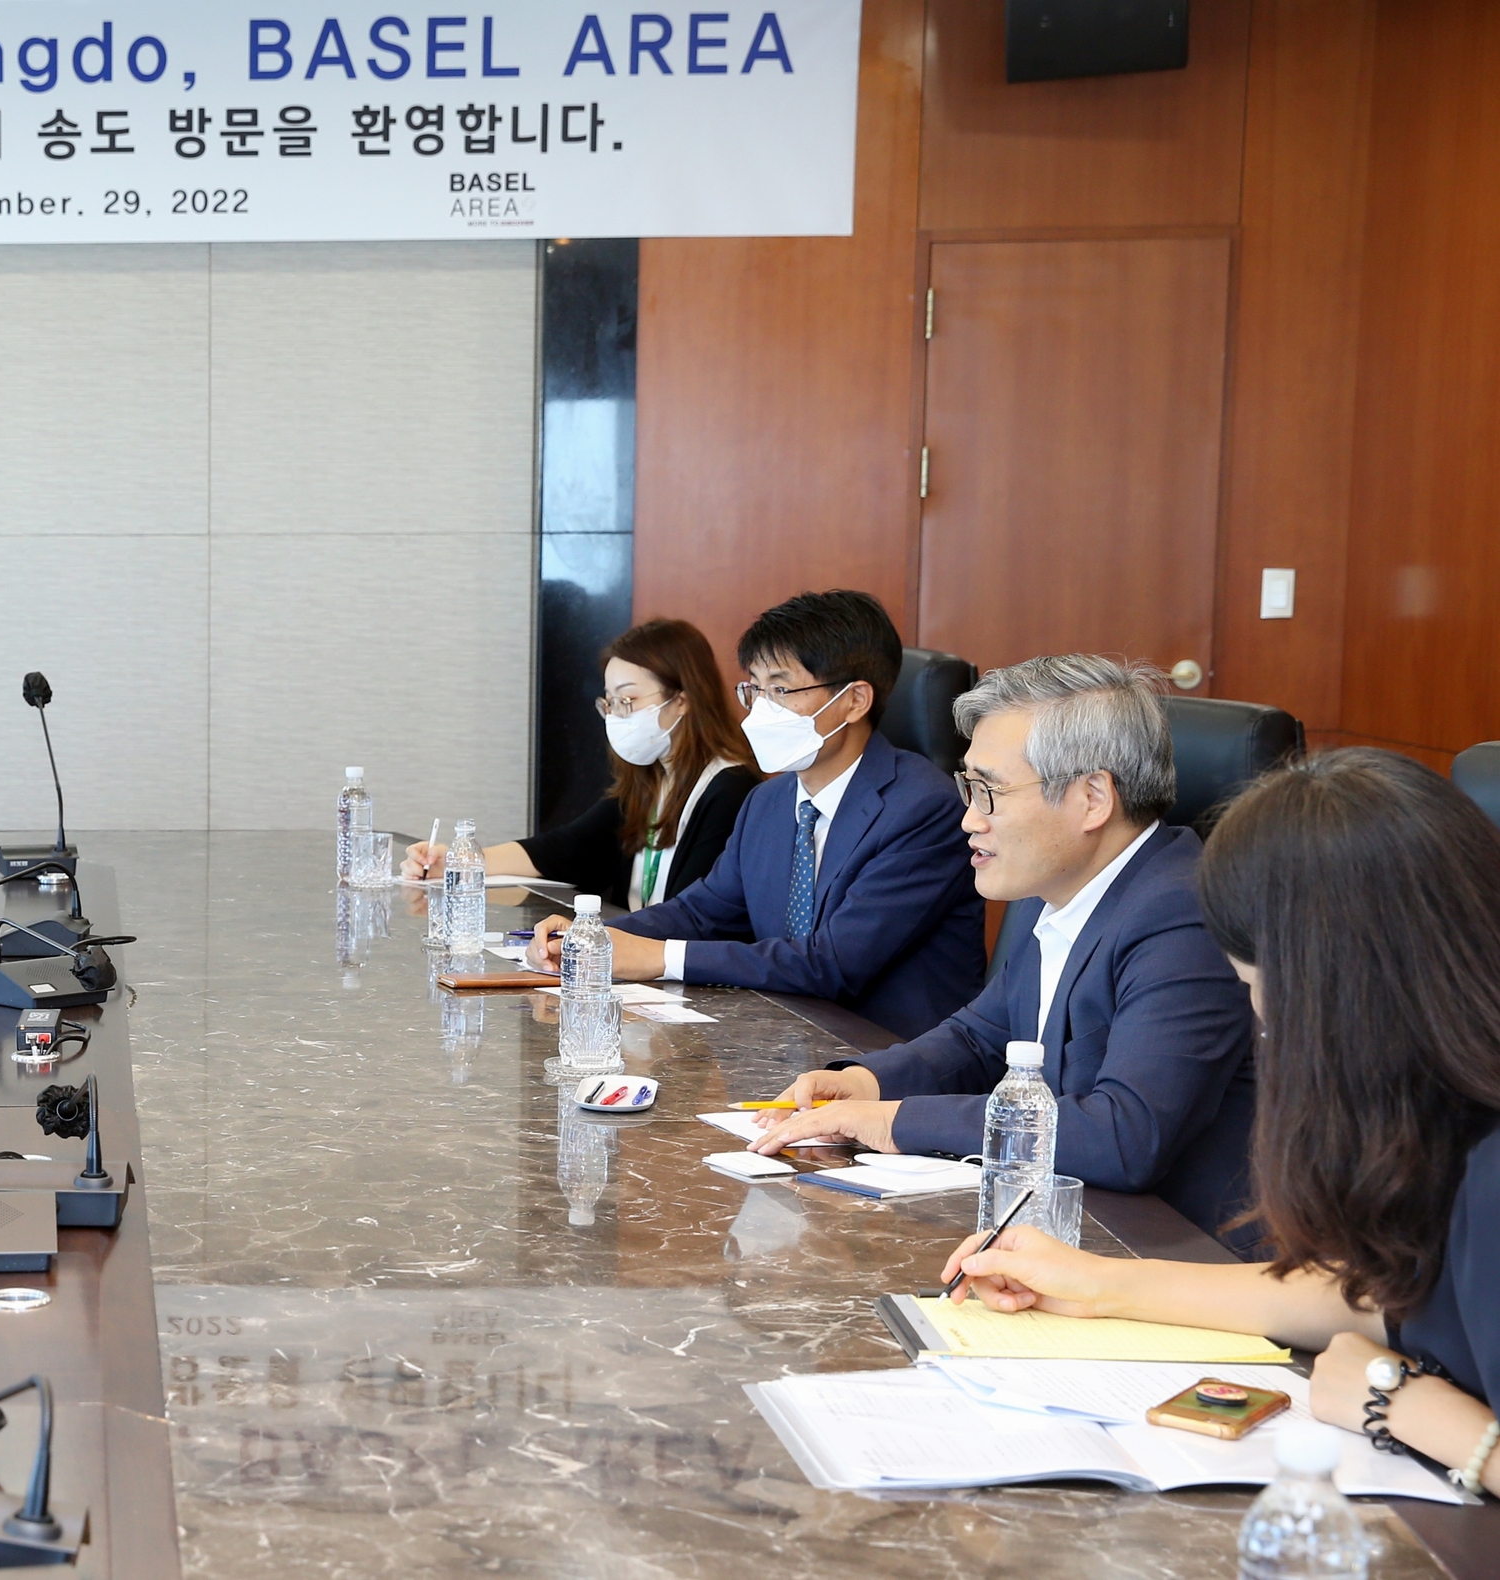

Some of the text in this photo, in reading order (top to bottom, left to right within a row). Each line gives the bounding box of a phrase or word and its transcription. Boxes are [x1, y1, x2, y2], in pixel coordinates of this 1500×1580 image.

[249, 15, 521, 82] BASEL
[563, 10, 795, 78] AREA
[37, 108, 135, 160] 송도
[169, 106, 318, 159] 방문을
[351, 102, 623, 156] 환영합니다.
[449, 172, 535, 192] BASEL
[104, 190, 152, 216] 29,
[172, 188, 249, 214] 2022
[450, 197, 519, 218] AREA
